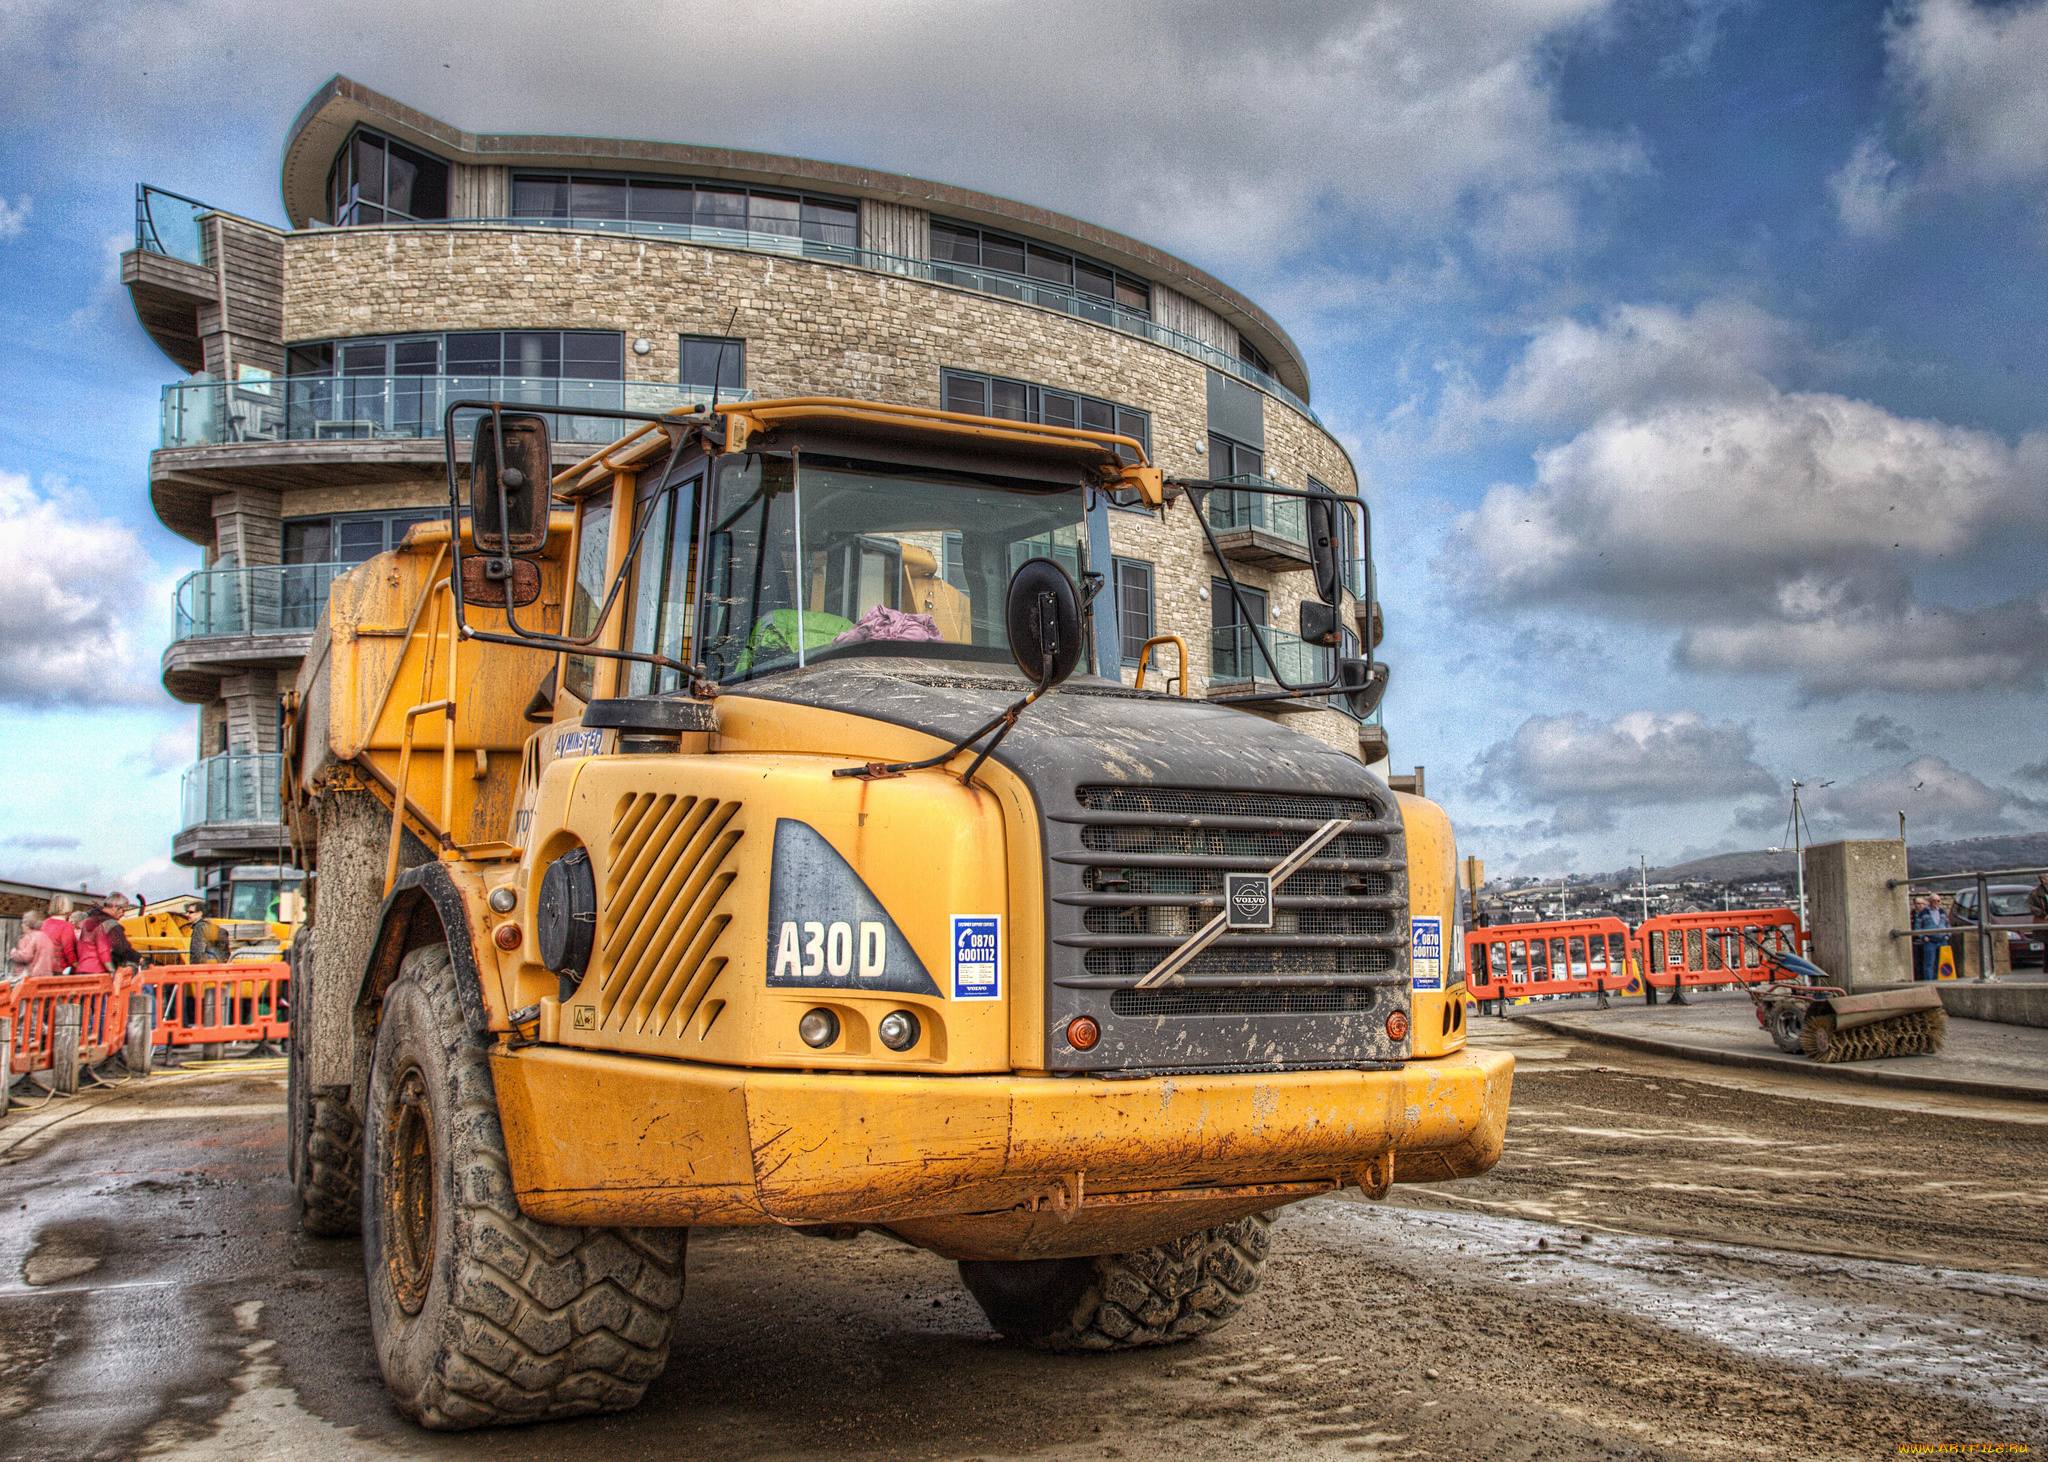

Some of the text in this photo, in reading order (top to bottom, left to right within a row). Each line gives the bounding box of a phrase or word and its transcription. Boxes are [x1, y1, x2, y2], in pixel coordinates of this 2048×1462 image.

[971, 934, 995, 947] 0870
[1422, 934, 1439, 945] 0870
[958, 948, 995, 961] 6001112
[1413, 946, 1439, 957] 6001112
